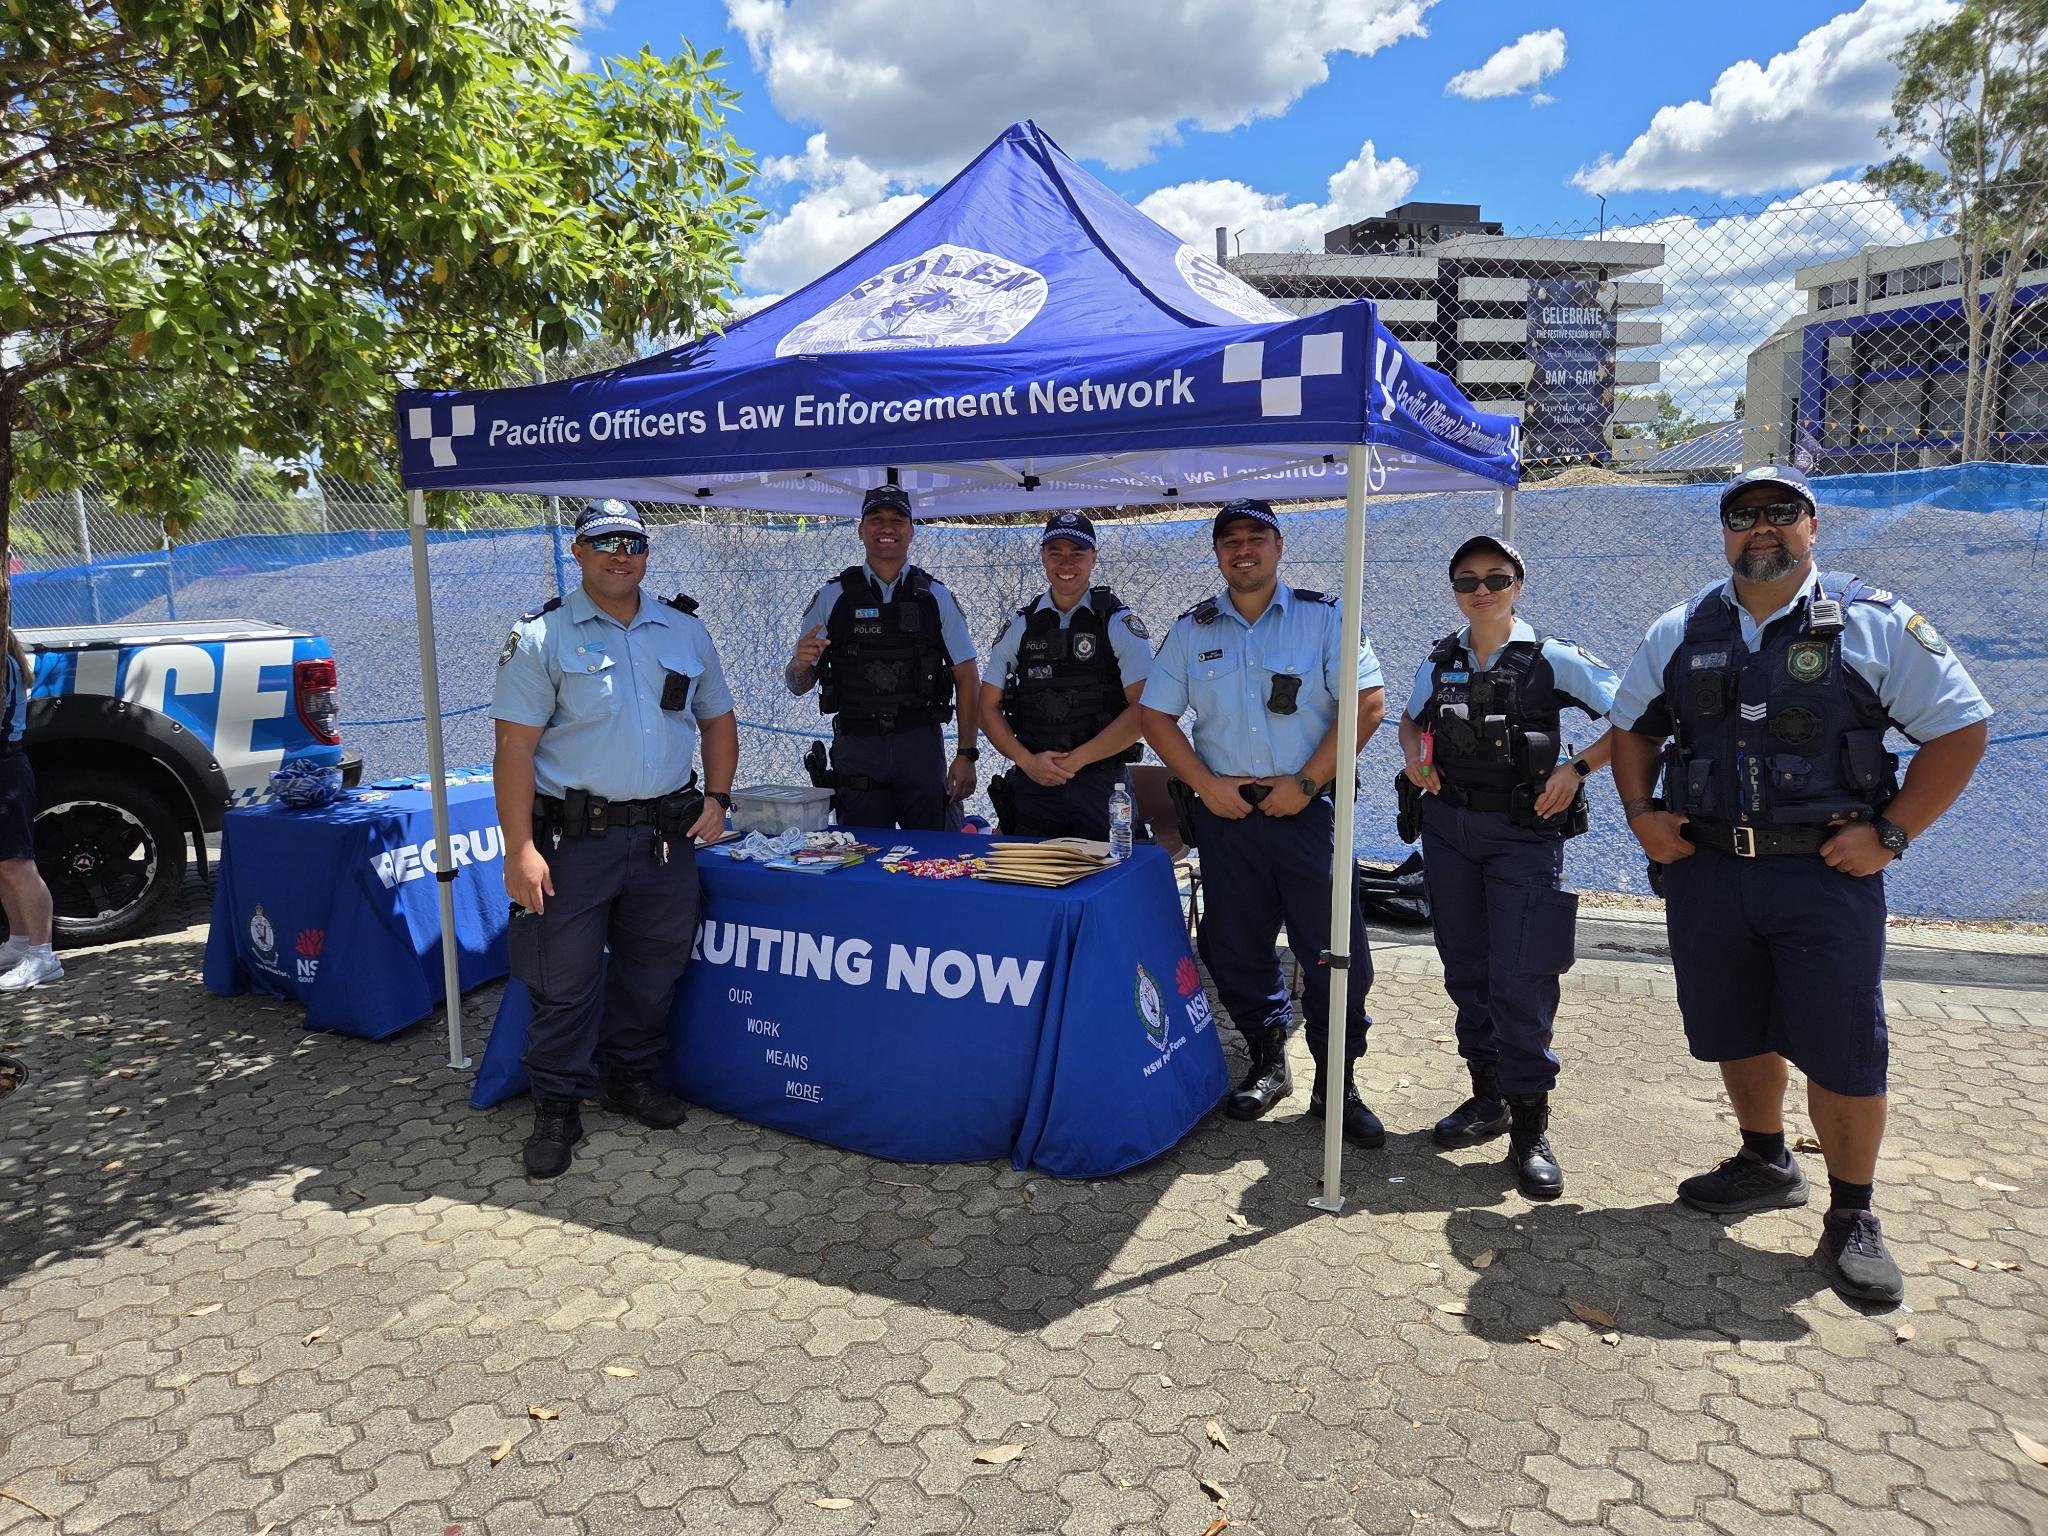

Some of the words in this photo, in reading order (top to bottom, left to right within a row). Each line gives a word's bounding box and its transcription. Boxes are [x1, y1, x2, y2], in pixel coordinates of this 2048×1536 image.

[850, 254, 1043, 301] POLEN
[1542, 307, 1601, 325] CELEBRATE
[1545, 370, 1566, 385] 9AM
[1576, 370, 1596, 385] 6AM
[489, 415, 581, 447] Pacific
[589, 406, 706, 442] Officers
[717, 400, 785, 432] Law
[794, 386, 1015, 427] Enforcement
[1028, 368, 1196, 415] Network
[854, 626, 882, 634] POLICE
[1437, 693, 1470, 703] POLICE
[1749, 757, 1760, 811] POLICE
[886, 943, 1046, 1007] NOW
[728, 988, 753, 1005] OUR
[747, 1017, 781, 1038] WORK
[1169, 1036, 1187, 1053] Force
[766, 1048, 809, 1071] MEANS
[1142, 1058, 1163, 1078] NSW
